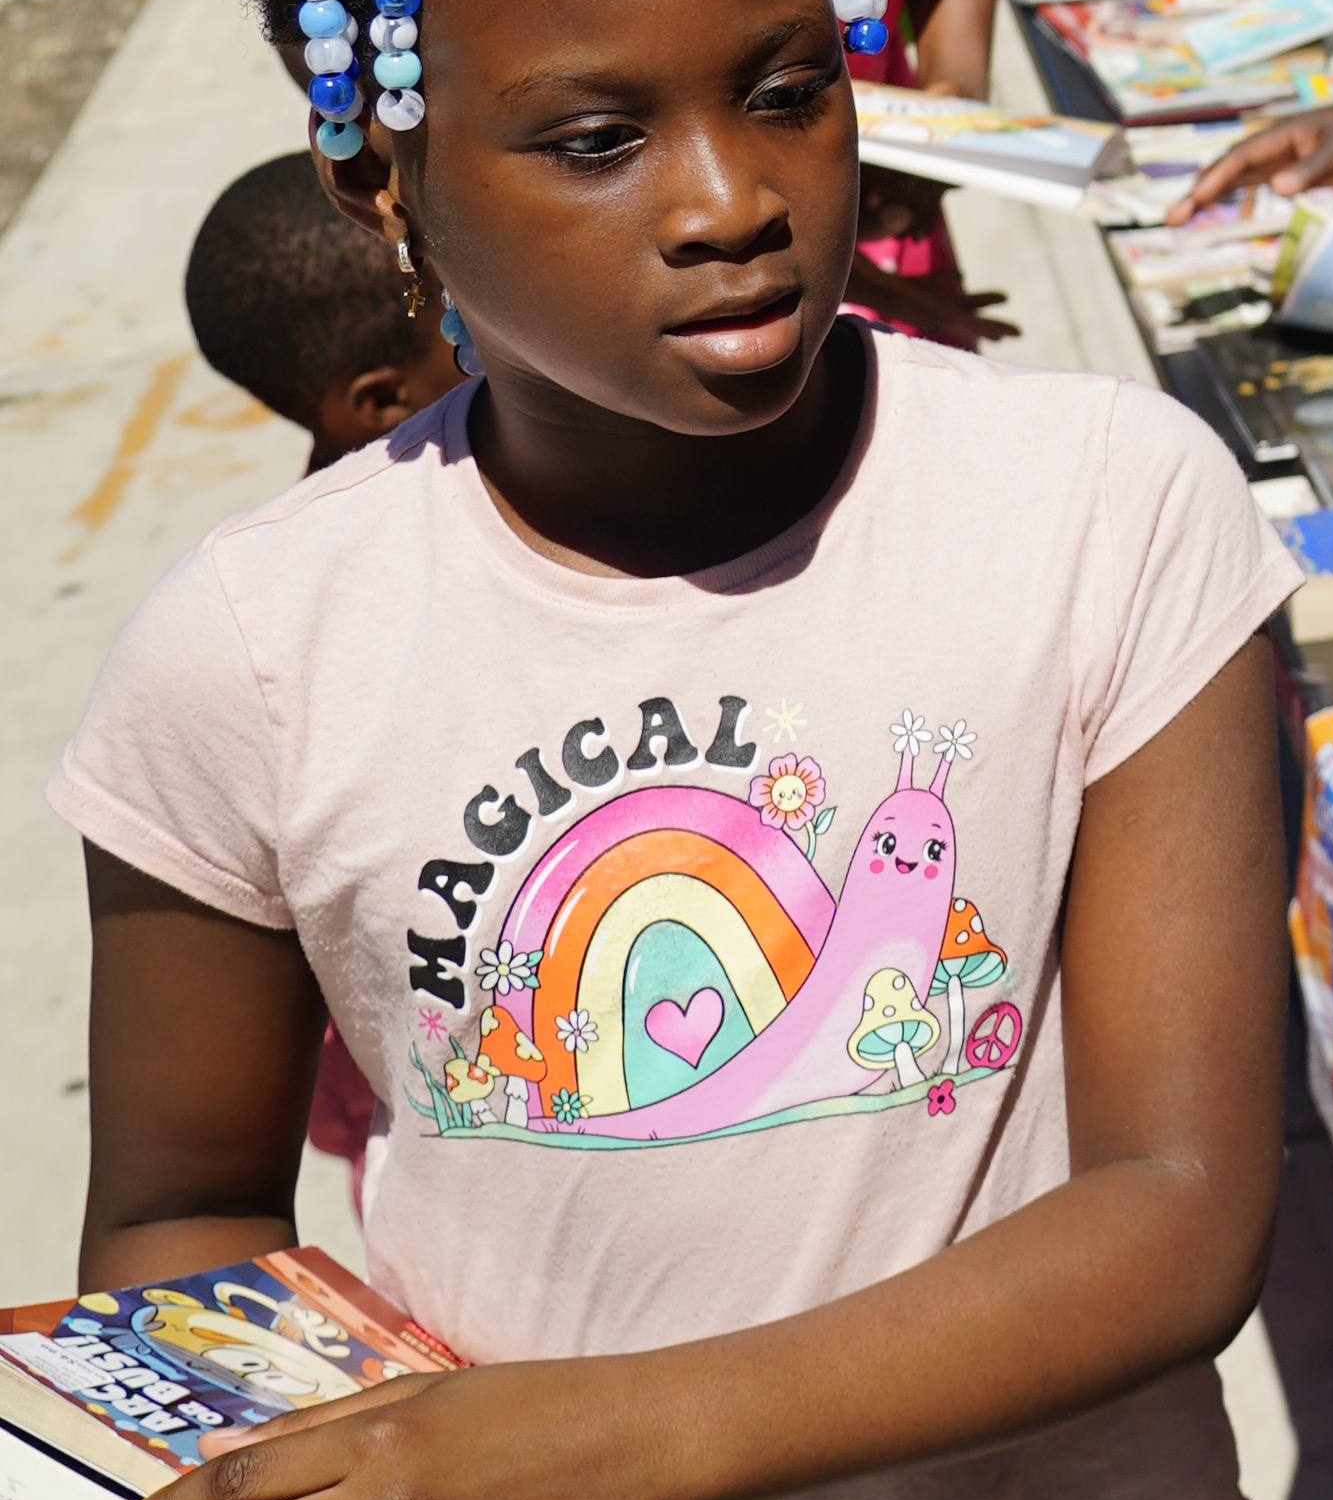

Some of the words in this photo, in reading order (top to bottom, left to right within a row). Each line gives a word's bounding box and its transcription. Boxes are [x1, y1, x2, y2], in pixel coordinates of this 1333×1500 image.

[406, 695, 758, 1012] MAGICAL
[53, 1335, 191, 1405] BUST!
[177, 1400, 224, 1427] OR
